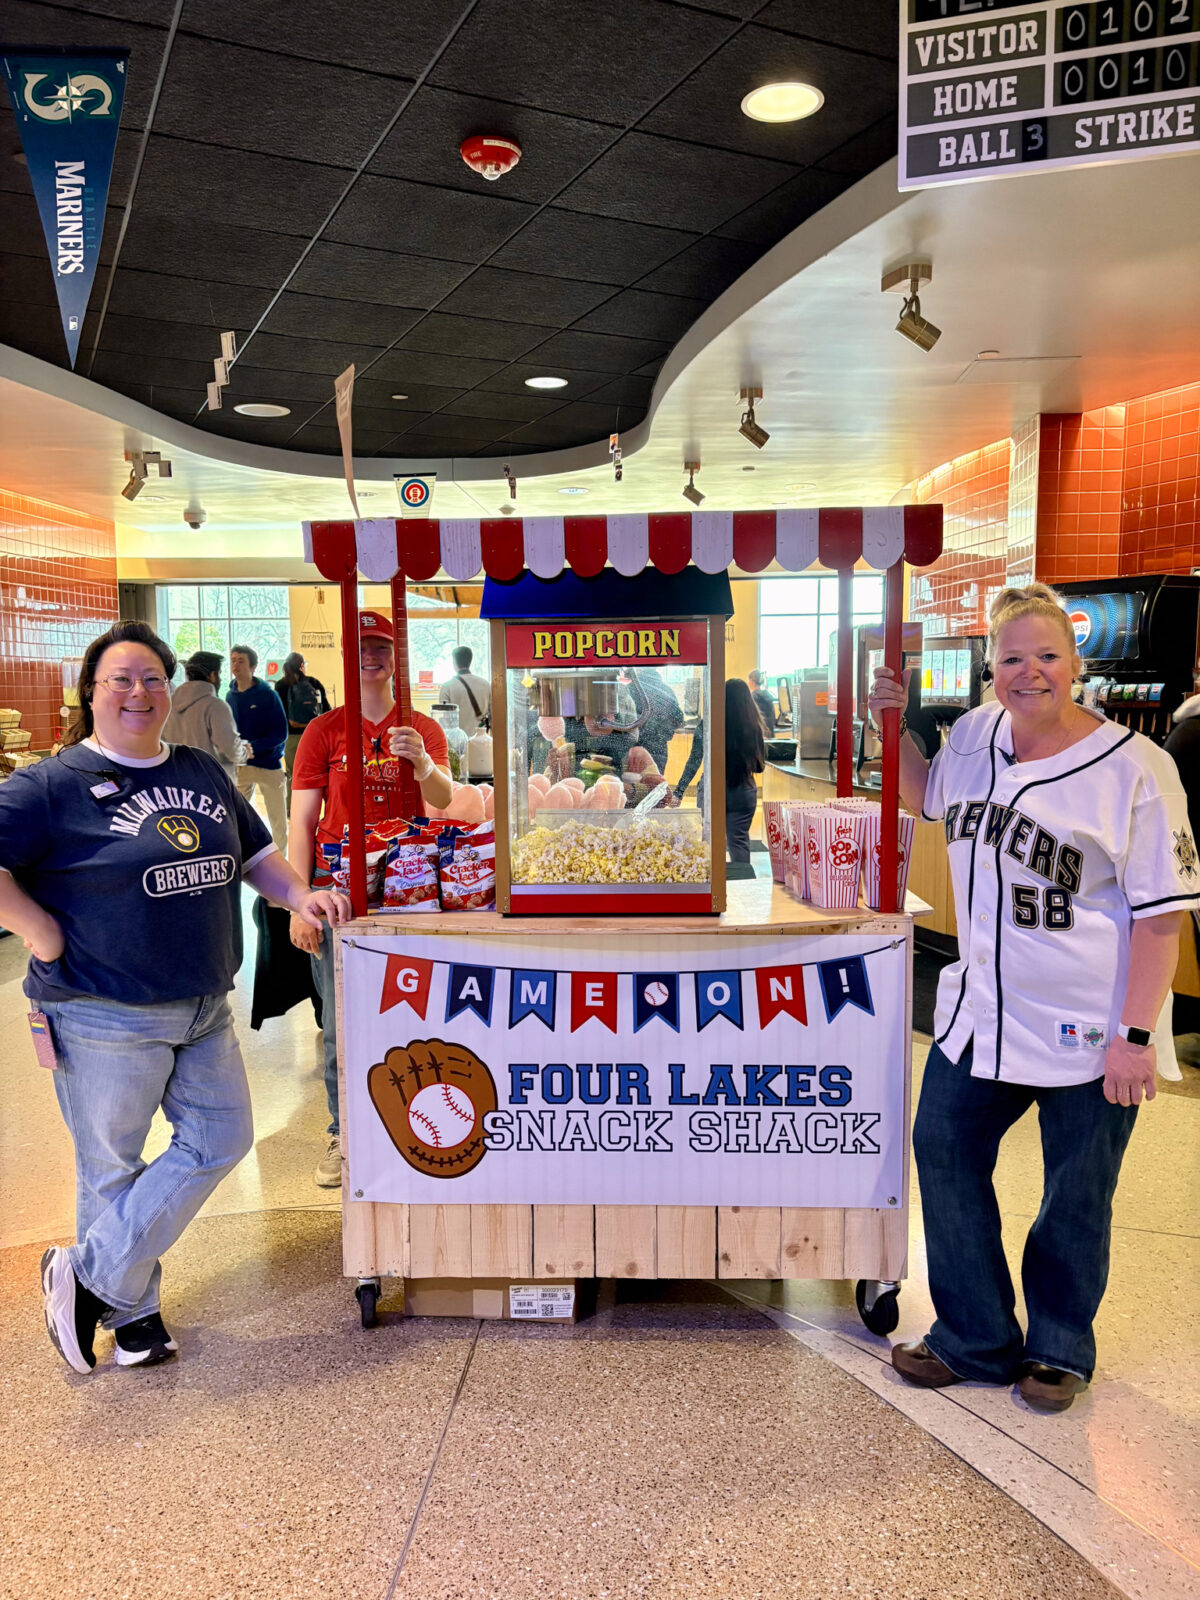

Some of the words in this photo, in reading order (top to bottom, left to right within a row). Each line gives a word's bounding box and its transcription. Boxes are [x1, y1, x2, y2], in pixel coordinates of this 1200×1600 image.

[915, 19, 1039, 67] VISITOR
[933, 75, 1018, 117] HOME
[938, 129, 1016, 168] BALL
[1026, 124, 1044, 151] 3
[1074, 103, 1196, 149] STRIKE
[54, 160, 86, 275] MARINERS
[532, 629, 681, 660] POPCORN
[109, 786, 227, 837] MILWAUKEE
[394, 856, 433, 870] Cracker
[831, 840, 851, 856] POP
[833, 848, 859, 866] CORN
[945, 800, 1084, 895] REWERS
[154, 859, 229, 892] BREWERS
[400, 866, 424, 878] Jack
[449, 861, 490, 875] Cracker
[455, 872, 480, 884] Jack
[457, 883, 483, 896] Original
[1011, 883, 1074, 931] 58
[396, 967, 604, 1007] GAME
[706, 967, 851, 1007] ON!
[508, 1063, 651, 1106] FOUR
[668, 1063, 852, 1107] LAKES
[482, 1110, 673, 1152] SNACK
[688, 1111, 881, 1154] SHACK
